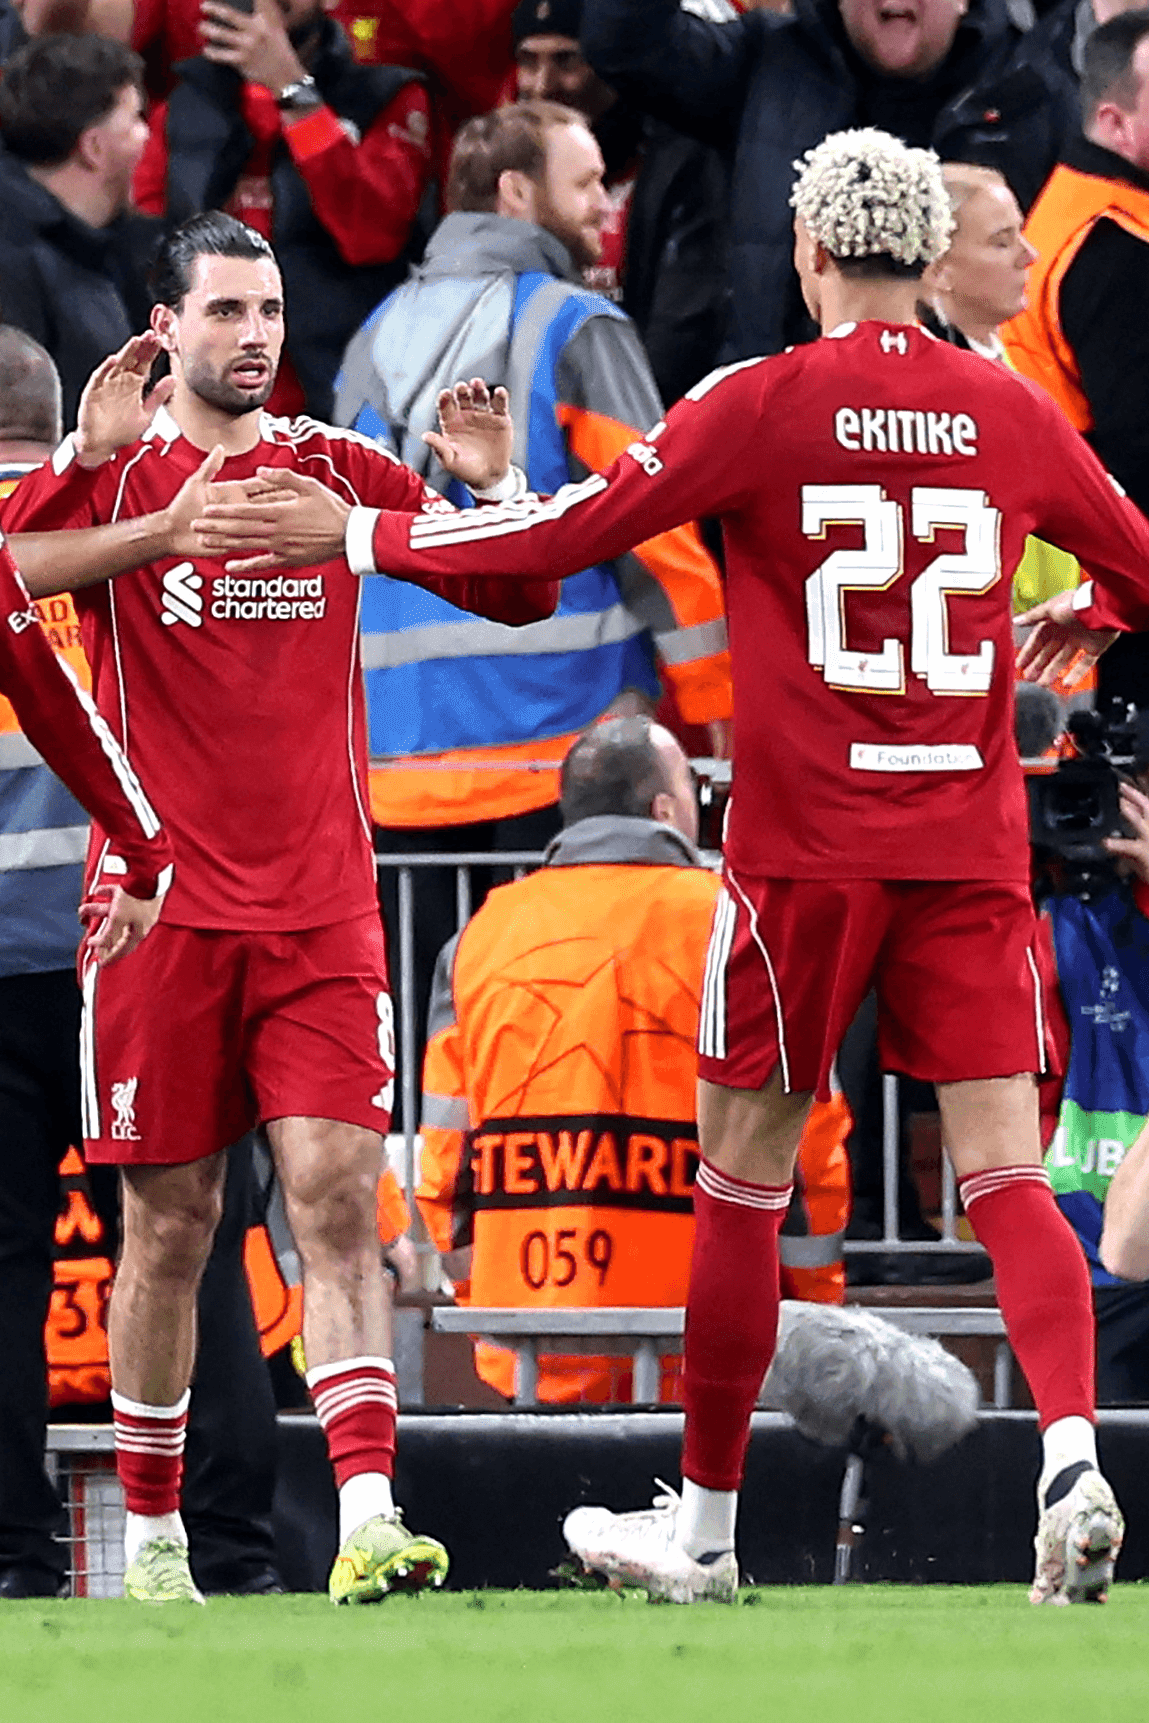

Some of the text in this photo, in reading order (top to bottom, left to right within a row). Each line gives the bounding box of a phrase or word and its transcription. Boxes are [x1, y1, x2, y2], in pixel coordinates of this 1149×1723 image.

[211, 575, 322, 598] standard
[801, 484, 1003, 696] 22
[211, 597, 326, 619] chartered
[522, 1229, 614, 1290] 059
